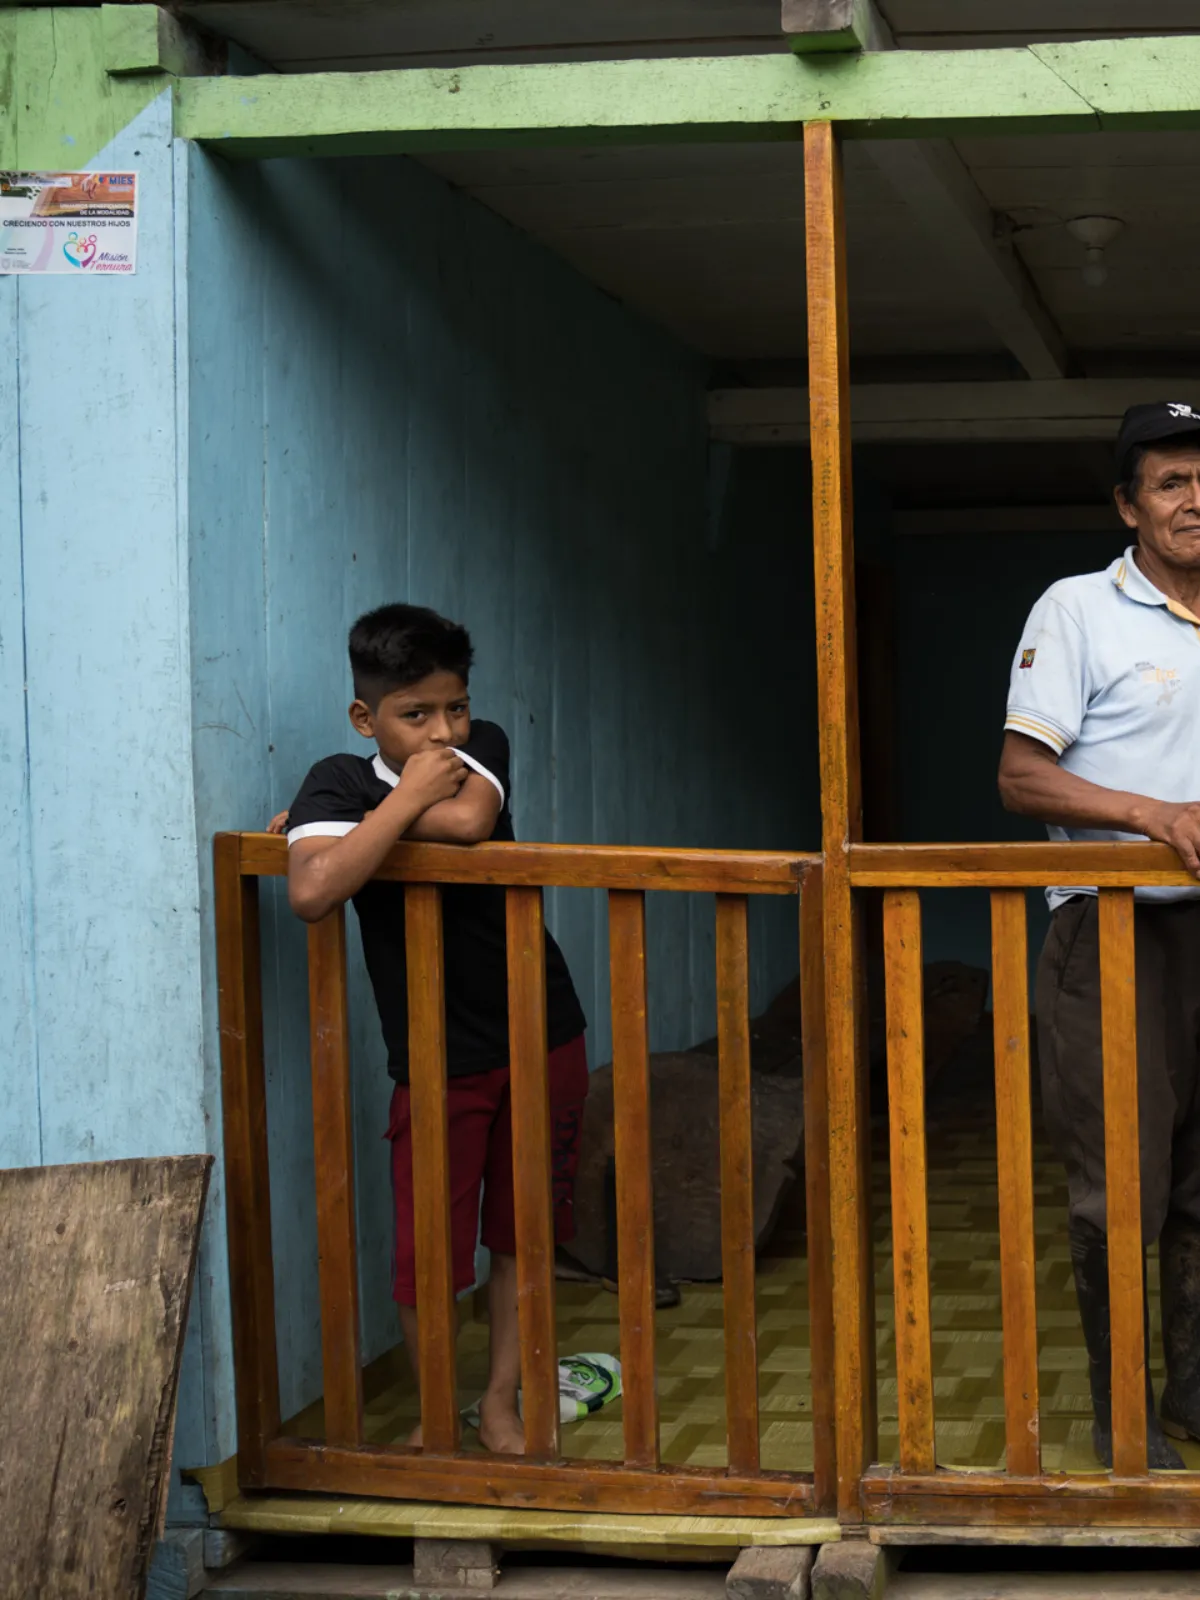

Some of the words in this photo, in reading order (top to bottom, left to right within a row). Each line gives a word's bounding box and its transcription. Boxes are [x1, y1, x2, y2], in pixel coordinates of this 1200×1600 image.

[109, 176, 133, 185] MIES
[98, 252, 128, 261] Misión
[90, 261, 133, 271] Ternura
